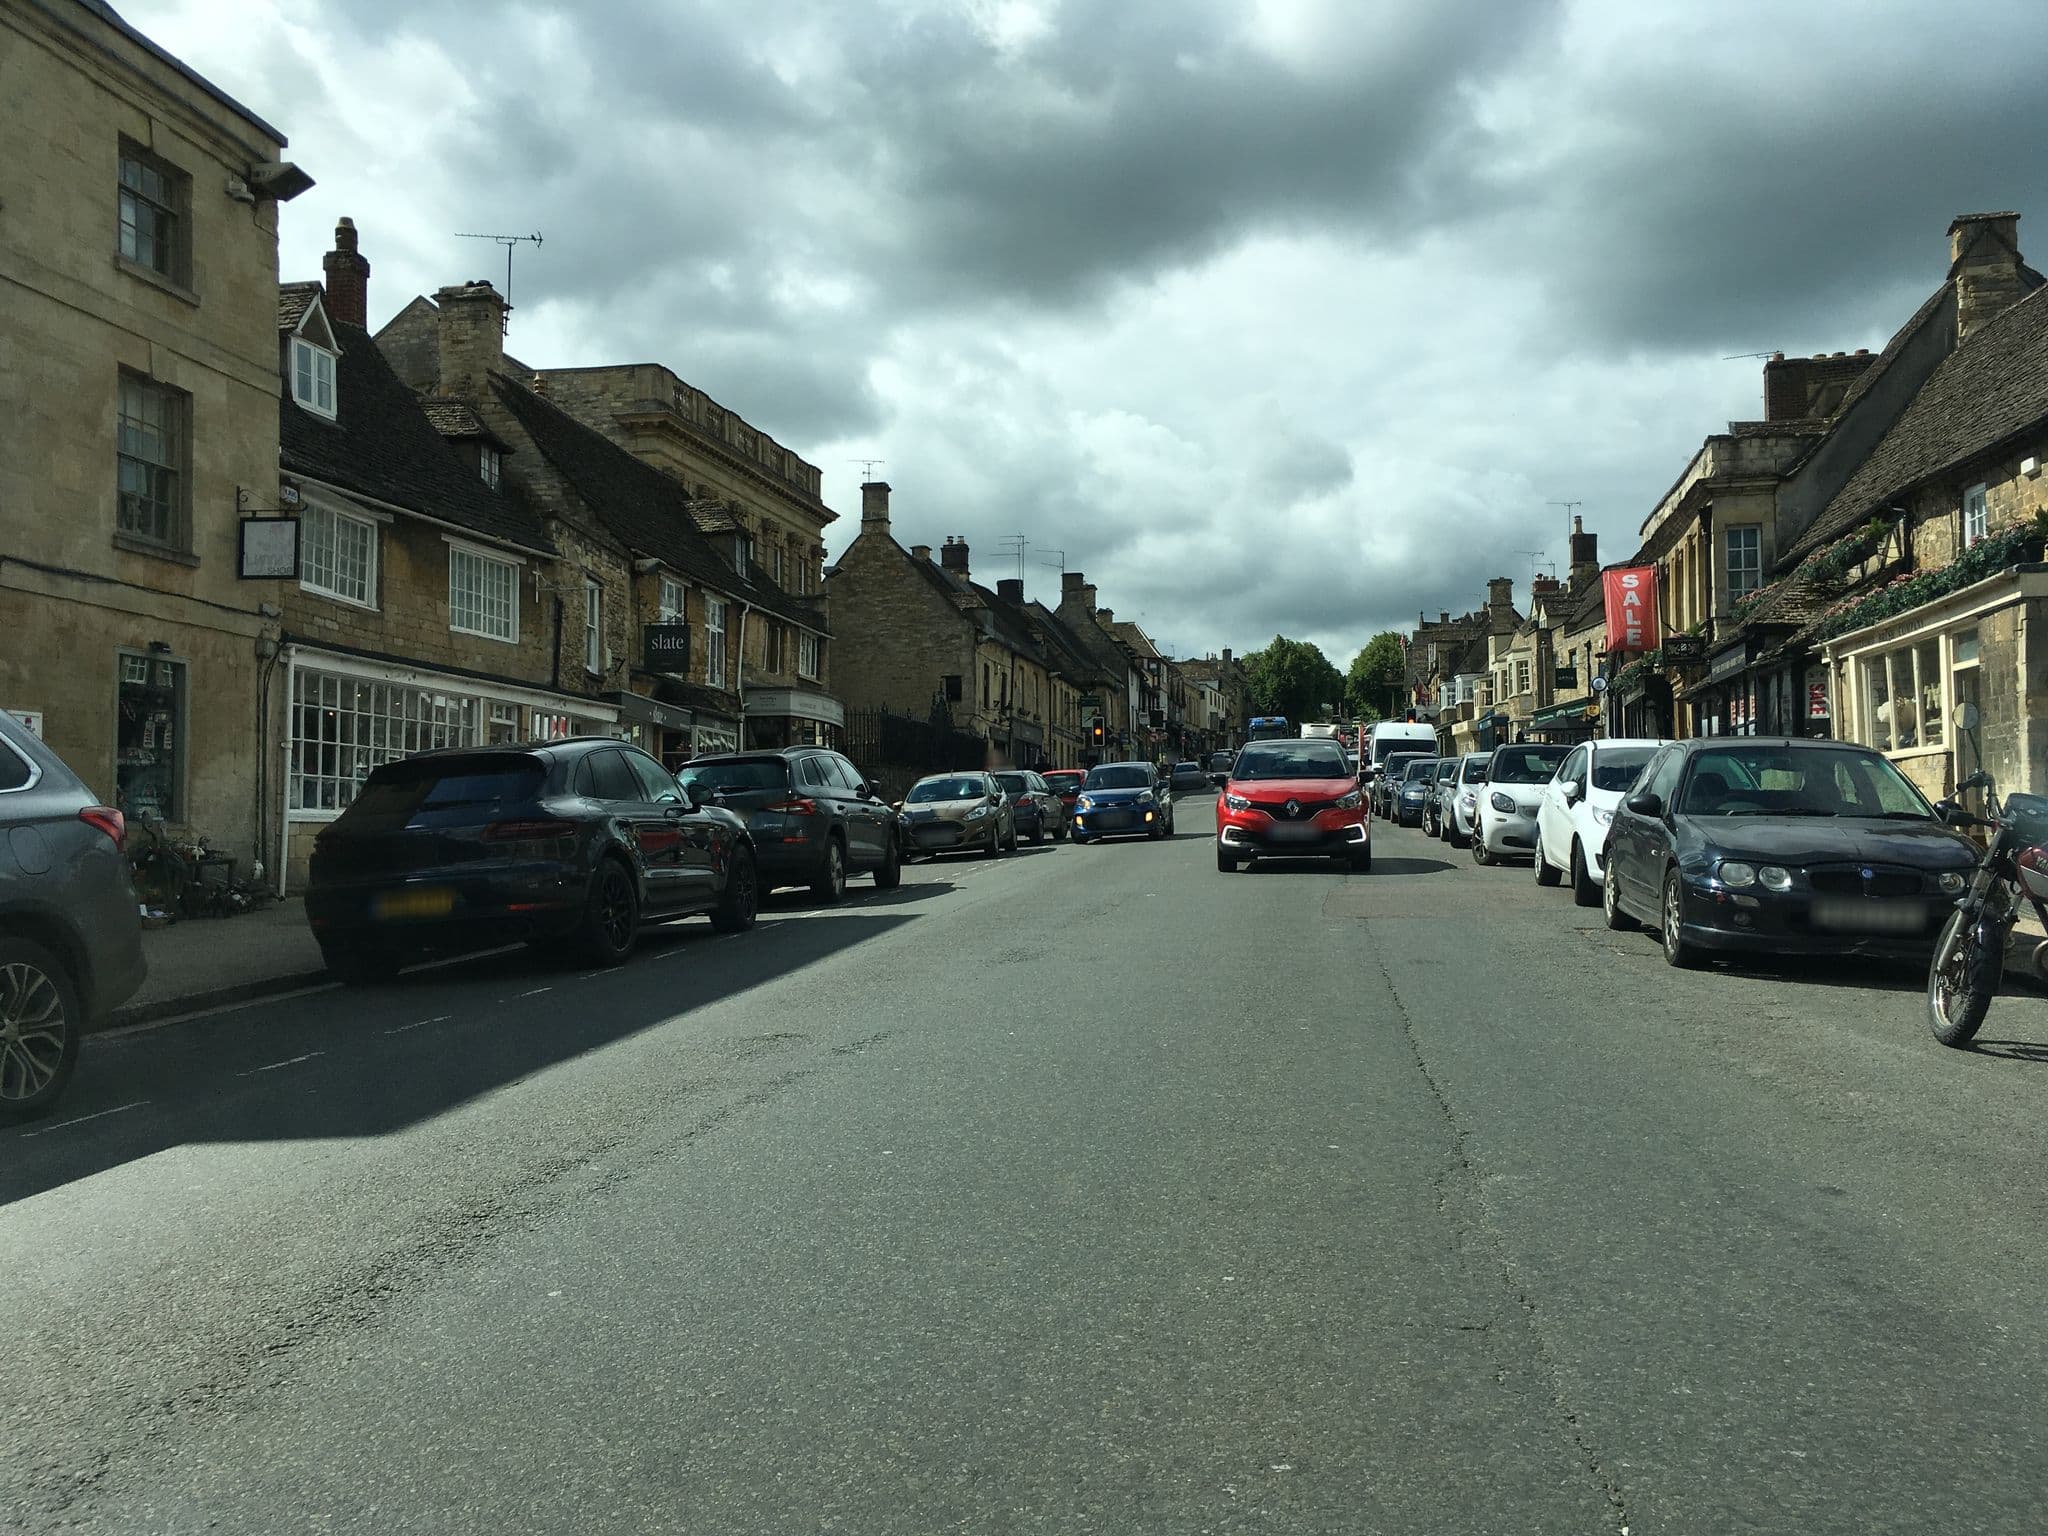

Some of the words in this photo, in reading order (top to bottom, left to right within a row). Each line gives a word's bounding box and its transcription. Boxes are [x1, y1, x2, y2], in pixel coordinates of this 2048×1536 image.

[1621, 574, 1642, 646] SALE
[651, 633, 684, 650] slate
[1809, 683, 1826, 715] SALE
